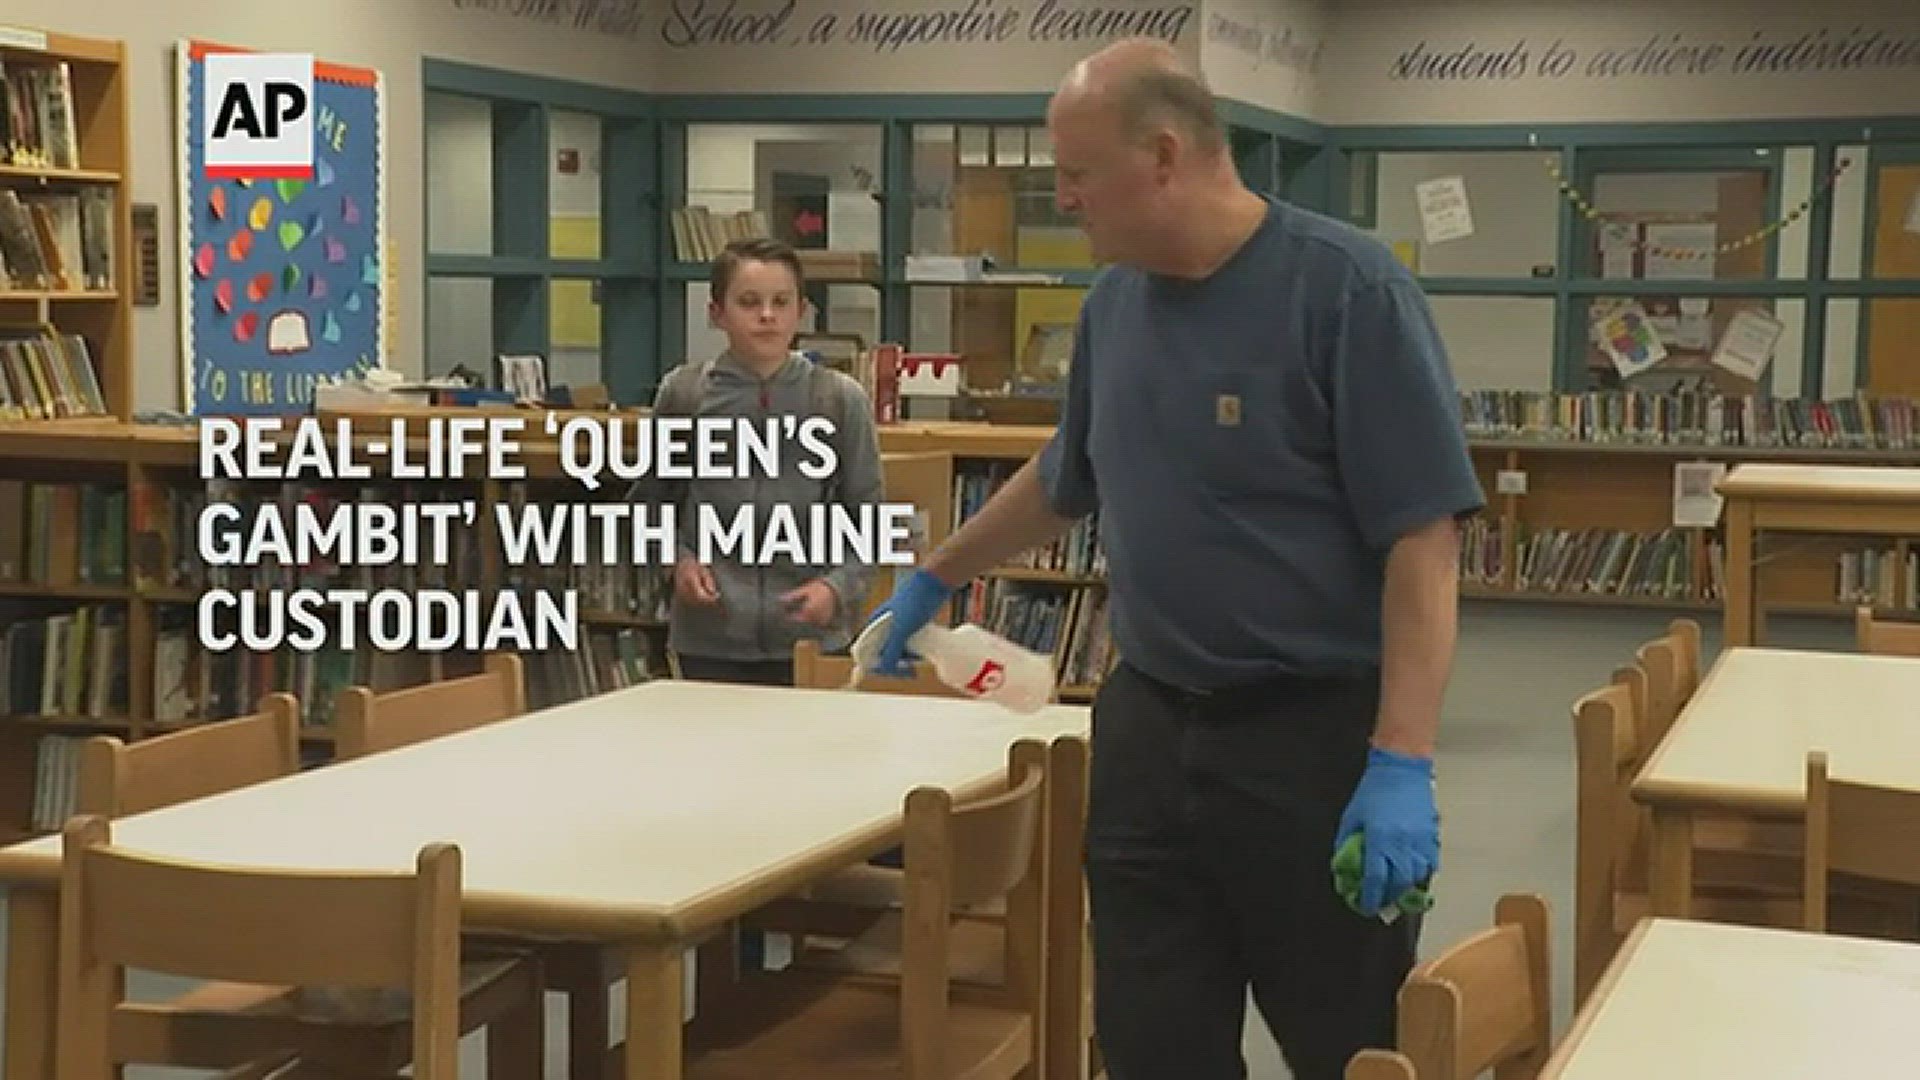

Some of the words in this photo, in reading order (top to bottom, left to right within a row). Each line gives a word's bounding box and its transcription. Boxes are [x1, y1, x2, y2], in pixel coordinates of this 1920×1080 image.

[807, 14, 838, 44] a
[846, 0, 1020, 52] supportive
[1028, 0, 1193, 45] learning
[1388, 39, 1528, 80] students
[1537, 37, 1577, 79] to
[1585, 33, 1724, 77] achieve
[200, 358, 227, 402] TO
